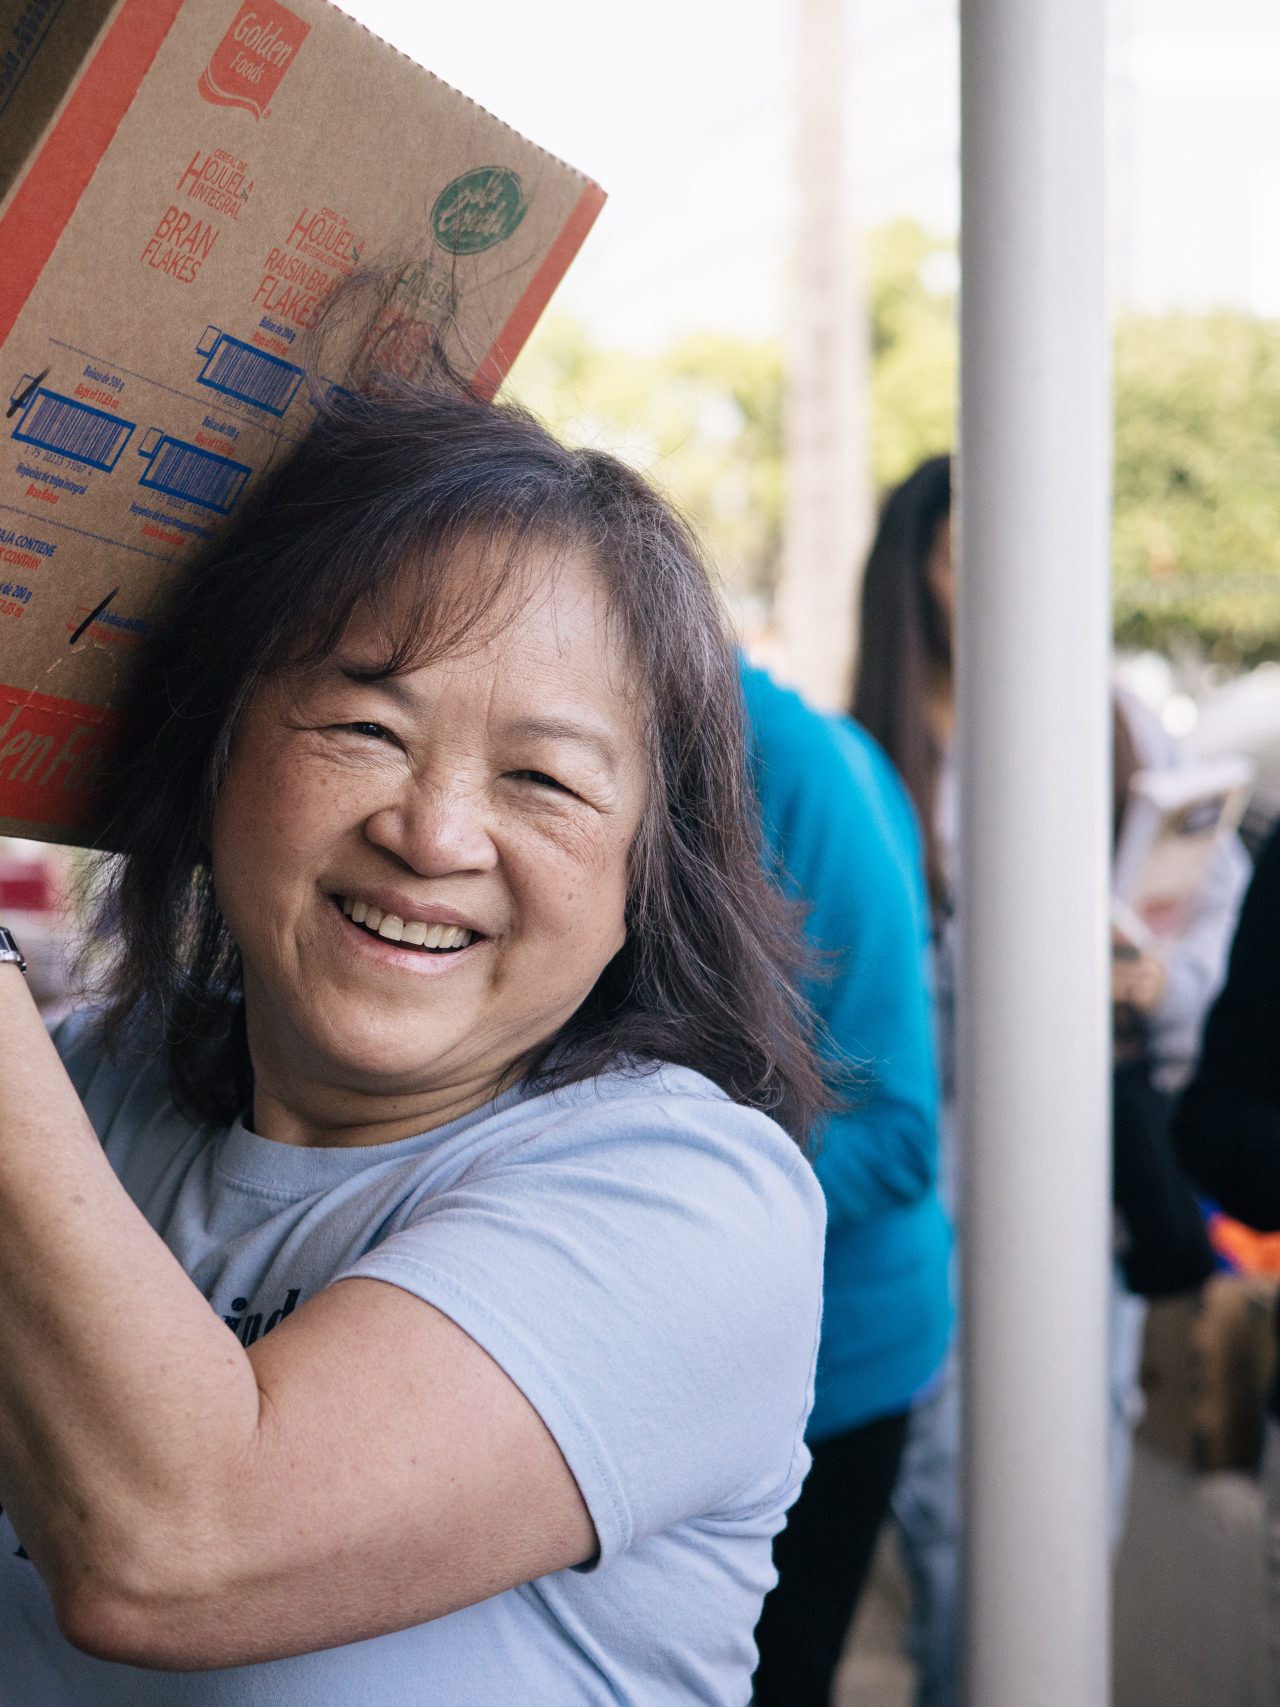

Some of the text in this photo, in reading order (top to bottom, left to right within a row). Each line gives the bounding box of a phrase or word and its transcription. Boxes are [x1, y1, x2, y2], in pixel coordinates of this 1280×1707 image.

[234, 14, 293, 68] Golden
[229, 50, 265, 83] Foods
[212, 147, 248, 173] CEREAL DE
[191, 181, 243, 220] INTEGRAL
[152, 205, 220, 260] BRAN
[139, 237, 202, 283] FLAKES
[262, 246, 312, 286] RAISIN
[251, 274, 327, 331] FLAKES
[73, 382, 91, 400] Bags
[88, 387, 99, 401] of
[82, 364, 103, 381] Bolsas
[100, 371, 111, 384] de
[117, 381, 125, 393] g
[1, 548, 43, 571] CONTAIN
[13, 533, 58, 558] CONTIENE
[0, 581, 15, 595] de
[21, 590, 33, 604] g
[208, 1288, 302, 1349] ind
